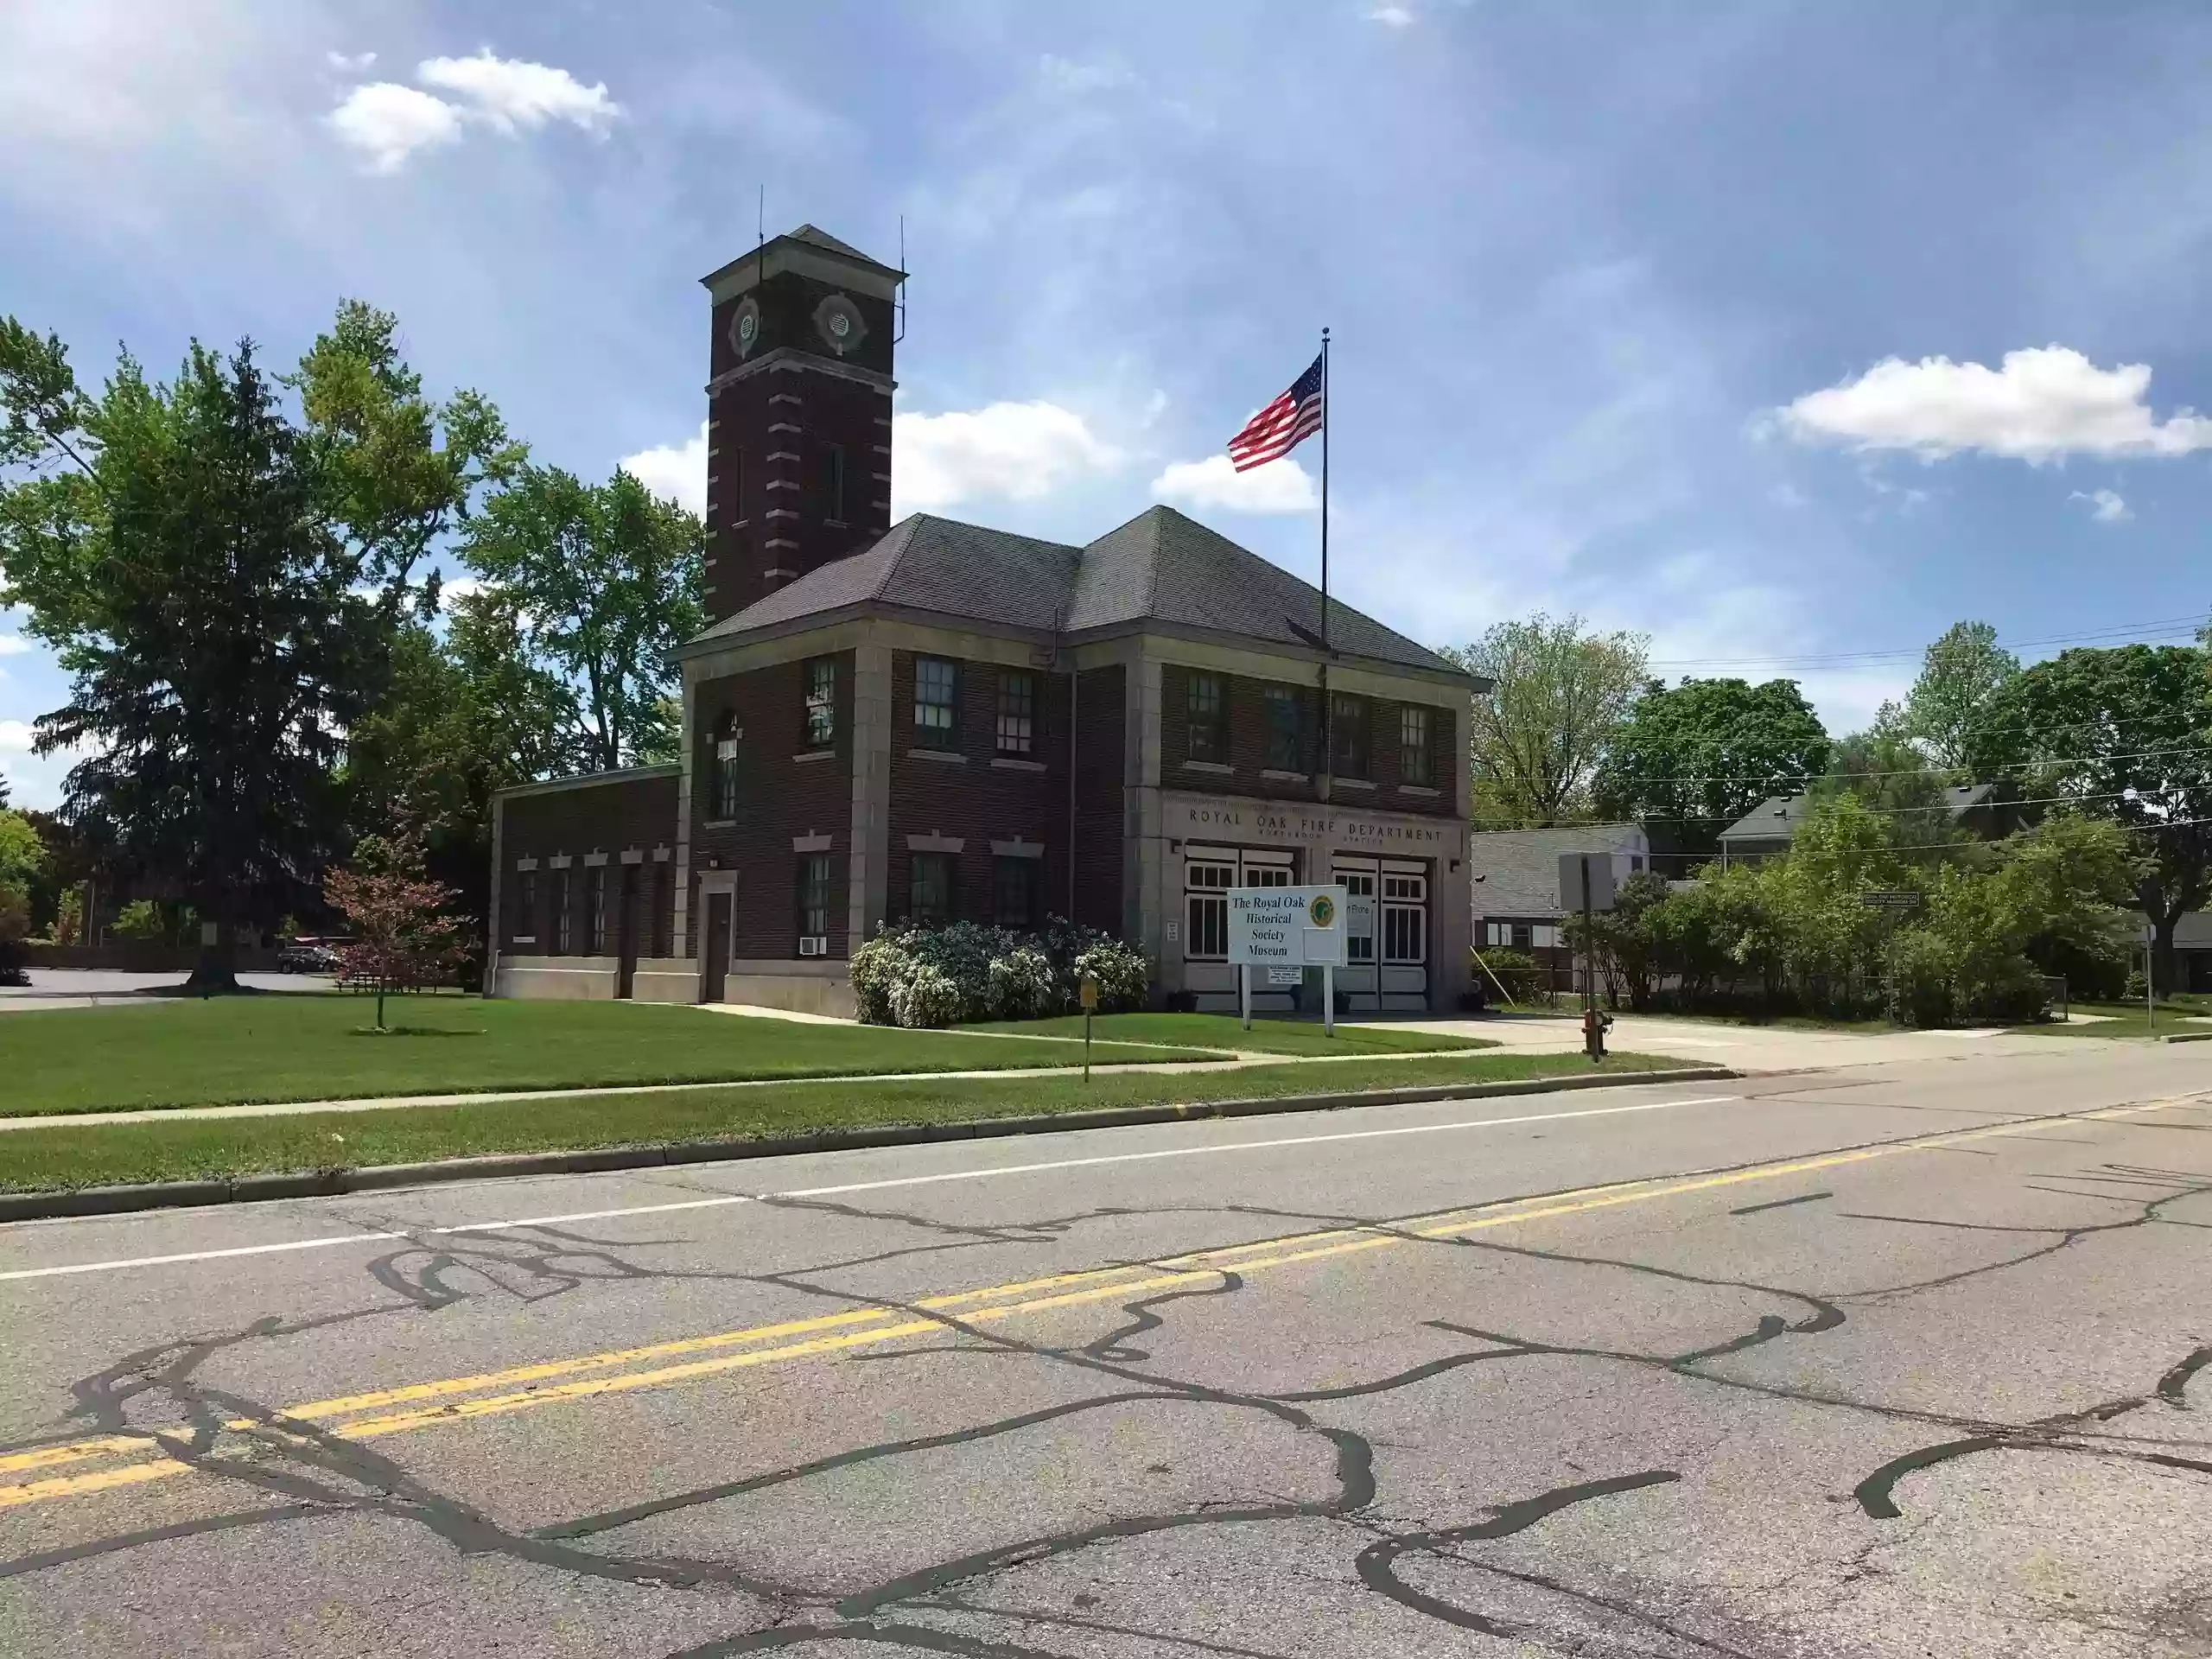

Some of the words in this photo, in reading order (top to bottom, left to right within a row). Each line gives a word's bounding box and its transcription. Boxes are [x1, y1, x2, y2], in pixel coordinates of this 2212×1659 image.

[1190, 808, 1241, 824] ROYAL
[1257, 816, 1287, 829] OAK
[1301, 819, 1335, 832] FIRE
[1349, 823, 1441, 841] DEPARTMENT
[1232, 898, 1250, 908] The
[1254, 897, 1281, 911] Royal
[1283, 897, 1306, 908] Oak
[1246, 913, 1292, 924] Historical
[1251, 929, 1286, 943] Society
[1249, 944, 1287, 957] Museum
